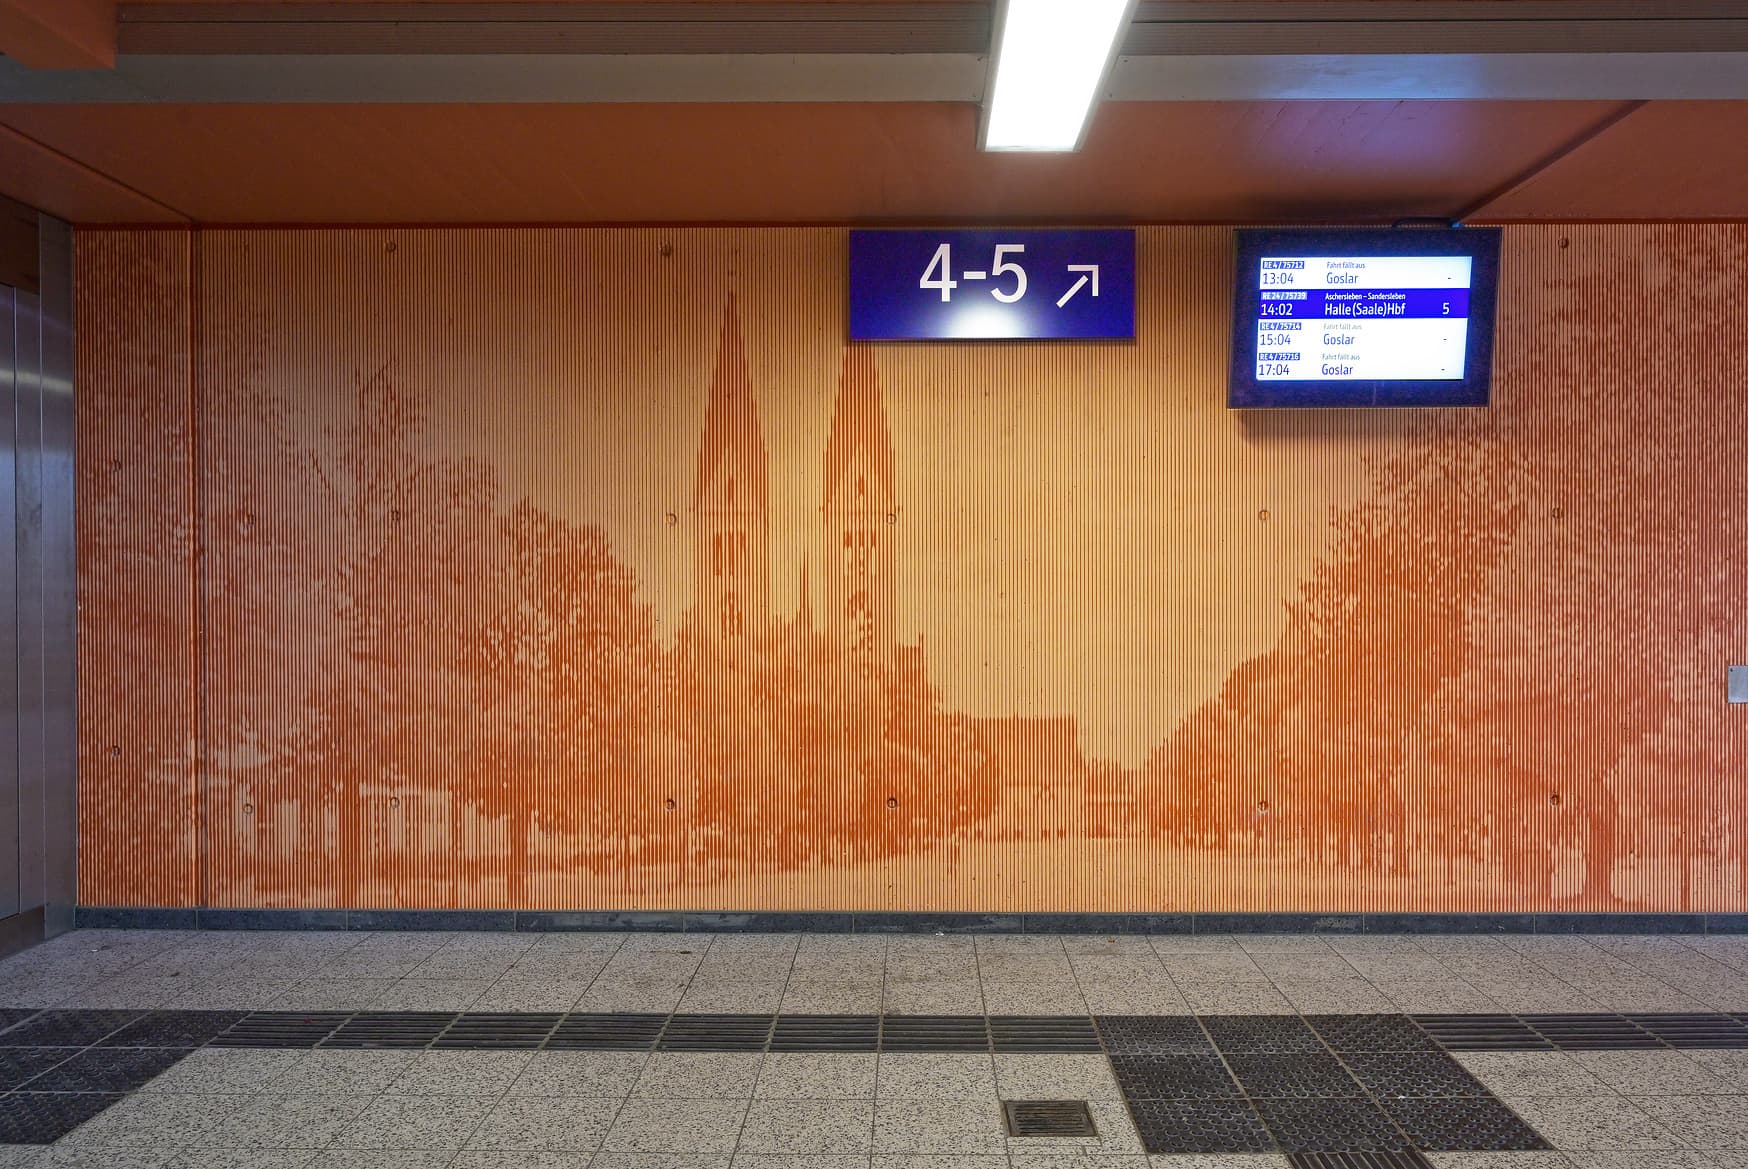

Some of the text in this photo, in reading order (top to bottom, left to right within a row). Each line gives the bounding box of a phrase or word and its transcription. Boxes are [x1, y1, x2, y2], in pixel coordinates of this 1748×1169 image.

[1327, 261, 1341, 269] Fahrt
[1343, 261, 1354, 269] fällt
[920, 243, 1028, 304] 4-5
[1263, 272, 1294, 285] 13:04
[1326, 272, 1359, 284] Goslar
[1325, 292, 1362, 300] Aschersleben
[1368, 292, 1406, 300] Sandersleben
[1261, 303, 1293, 316] 14:02
[1442, 302, 1450, 315] 5
[1260, 333, 1291, 346] 15:04
[1323, 333, 1355, 345] Goslar
[1258, 363, 1290, 376] 17:04
[1321, 363, 1354, 375] Goslar
